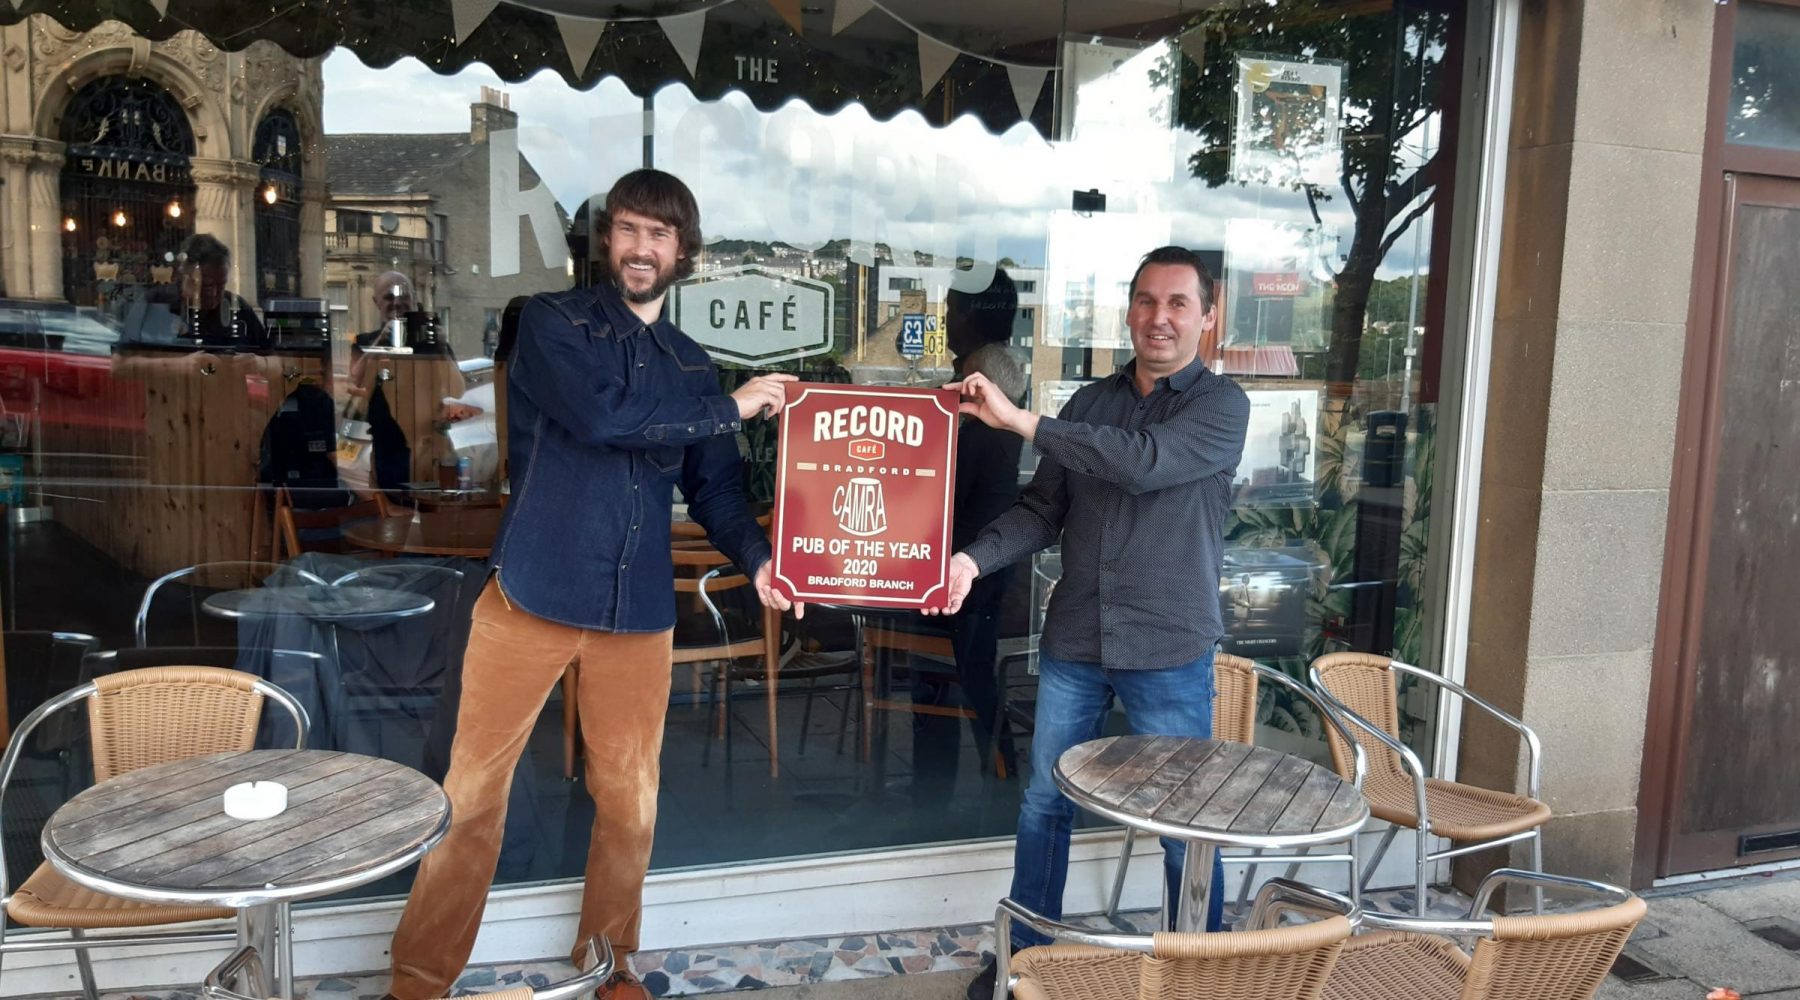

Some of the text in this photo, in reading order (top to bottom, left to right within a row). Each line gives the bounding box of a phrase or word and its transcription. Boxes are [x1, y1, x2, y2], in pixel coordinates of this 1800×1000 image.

[734, 55, 779, 84] THE
[709, 295, 798, 334] CAFÉ
[813, 405, 924, 447] RECORD
[856, 444, 877, 454] CAFÉ
[822, 463, 910, 476] BRADFORD
[832, 482, 887, 533] CAMRA
[792, 536, 931, 560] PUB OF THE YEAR
[843, 558, 878, 576] 2020
[808, 575, 914, 590] BRADFORD BRANCH
